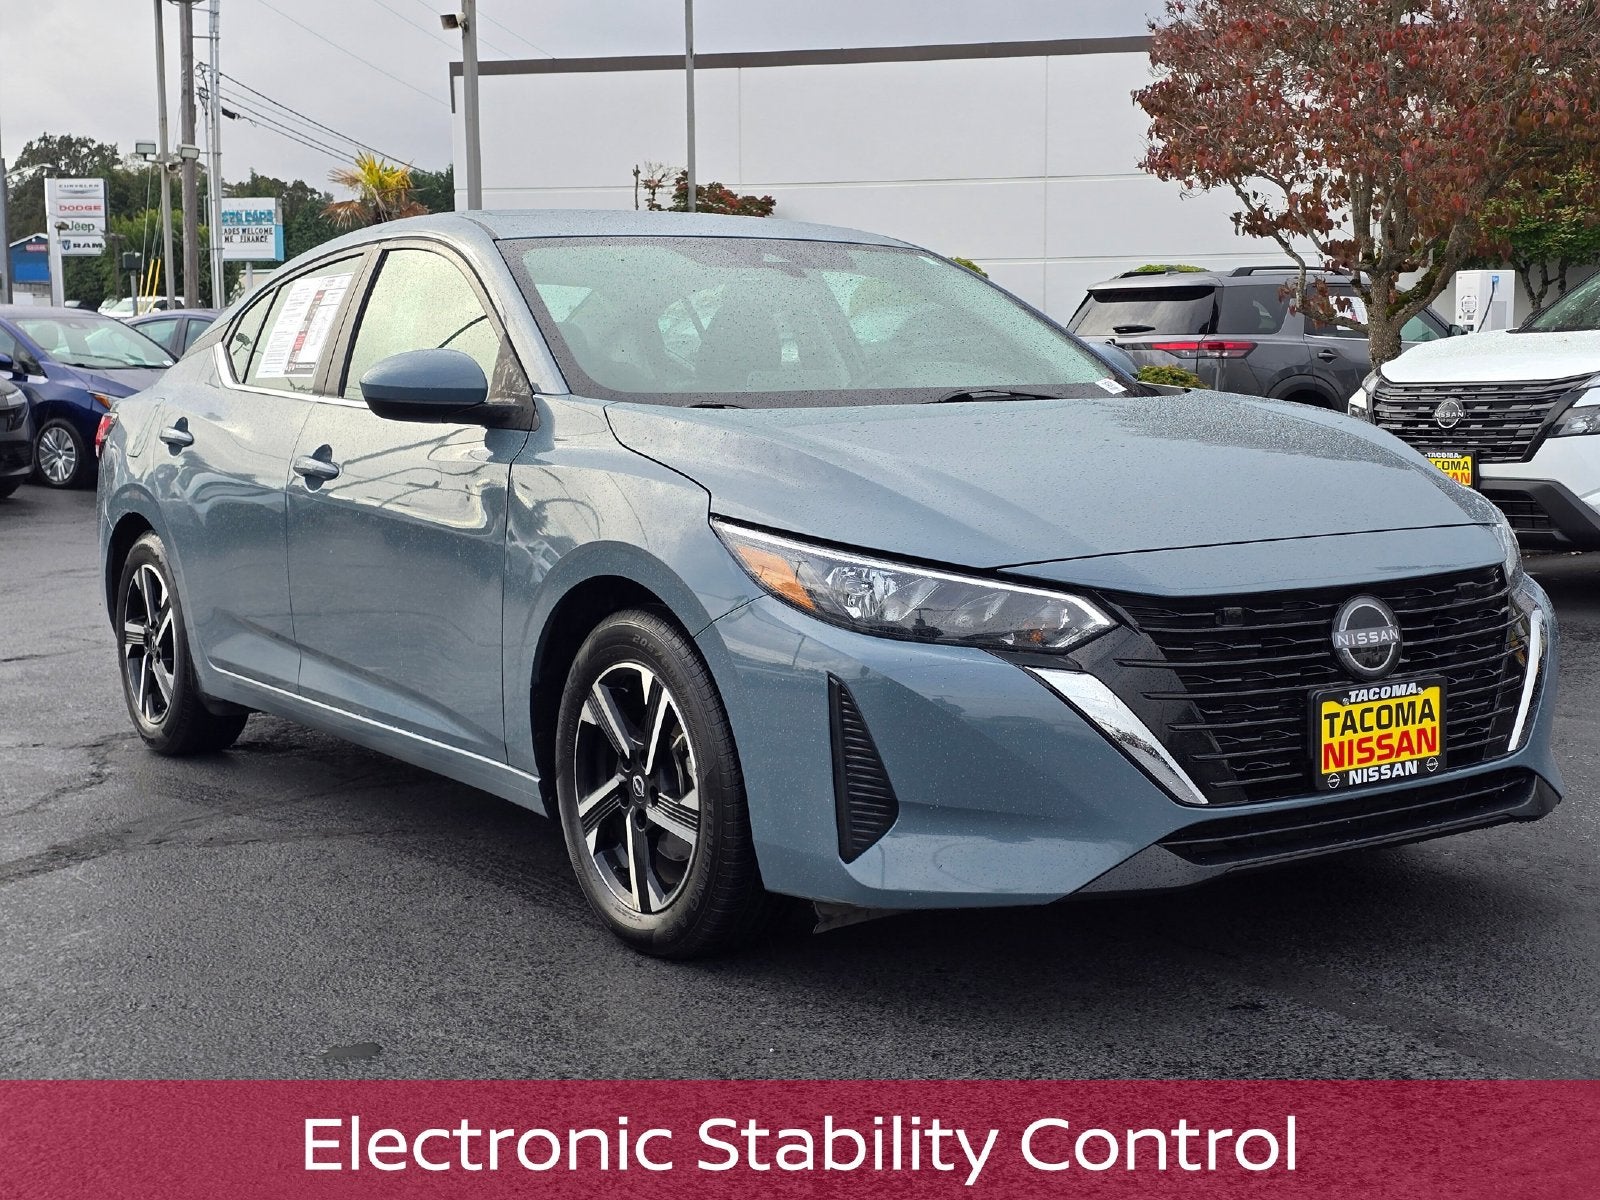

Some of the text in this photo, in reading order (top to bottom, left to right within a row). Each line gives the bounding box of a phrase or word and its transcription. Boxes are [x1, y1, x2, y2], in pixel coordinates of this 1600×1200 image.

[68, 221, 95, 233] Jeep
[241, 227, 273, 235] WELCOME
[239, 235, 268, 243] FINANCE
[1434, 409, 1464, 418] NISSAN
[1431, 460, 1470, 471] COMA
[1337, 626, 1399, 647] NISSAN
[1348, 682, 1417, 703] TACOMA
[1324, 698, 1436, 738] TACOMA
[1323, 726, 1437, 770] NISSAN
[1348, 760, 1418, 785] NISSAN
